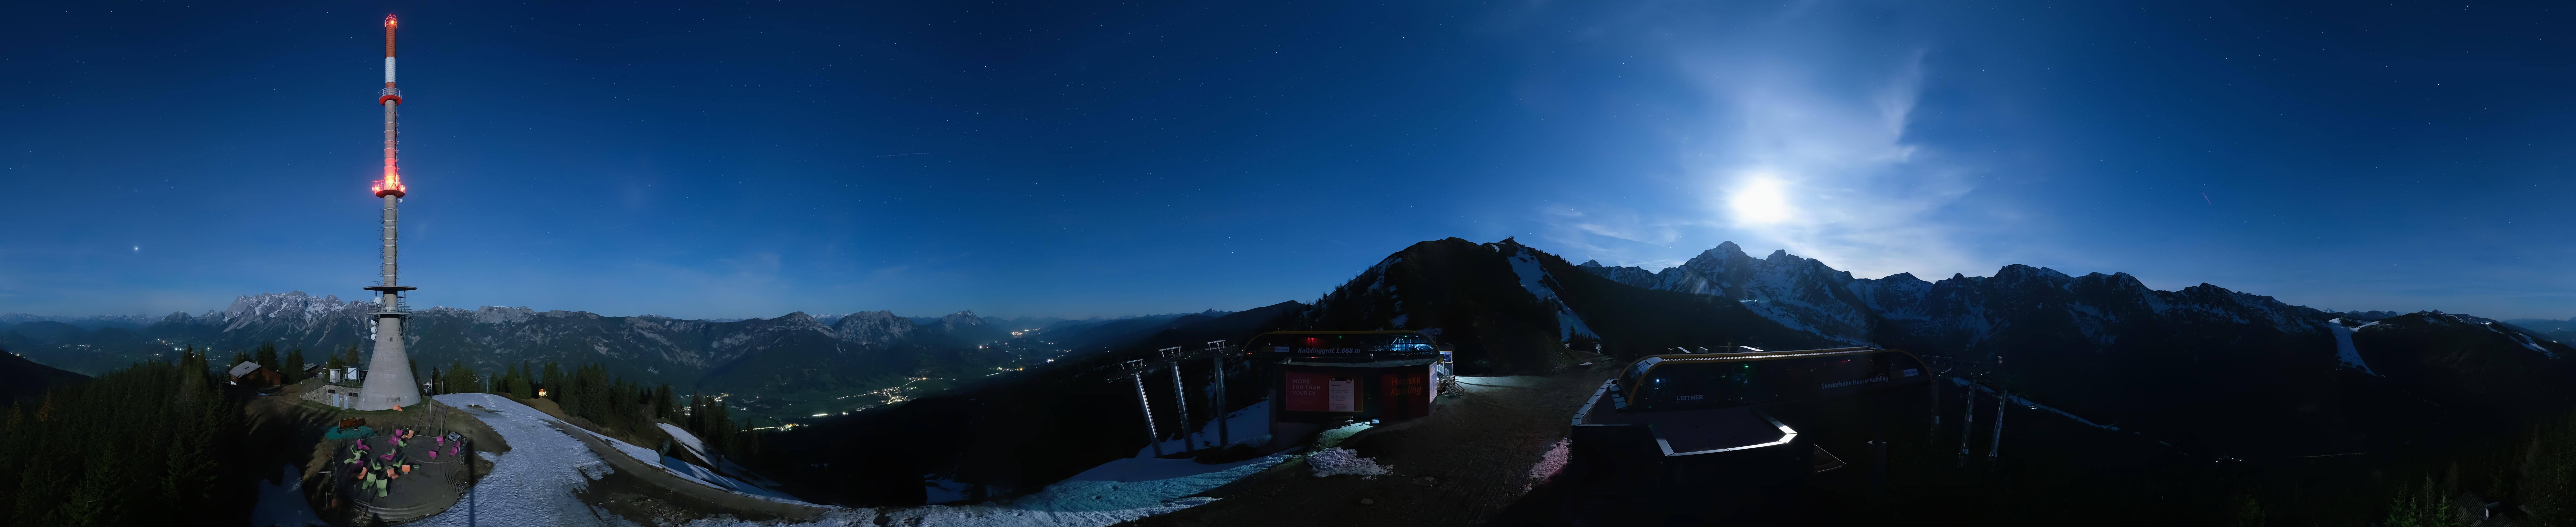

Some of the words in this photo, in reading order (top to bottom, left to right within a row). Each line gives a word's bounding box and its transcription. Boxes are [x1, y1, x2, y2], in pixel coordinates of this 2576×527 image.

[1391, 377, 1421, 386] HAUSER
[1821, 380, 1852, 389] Senderbahn
[1391, 386, 1421, 396] Kaibling
